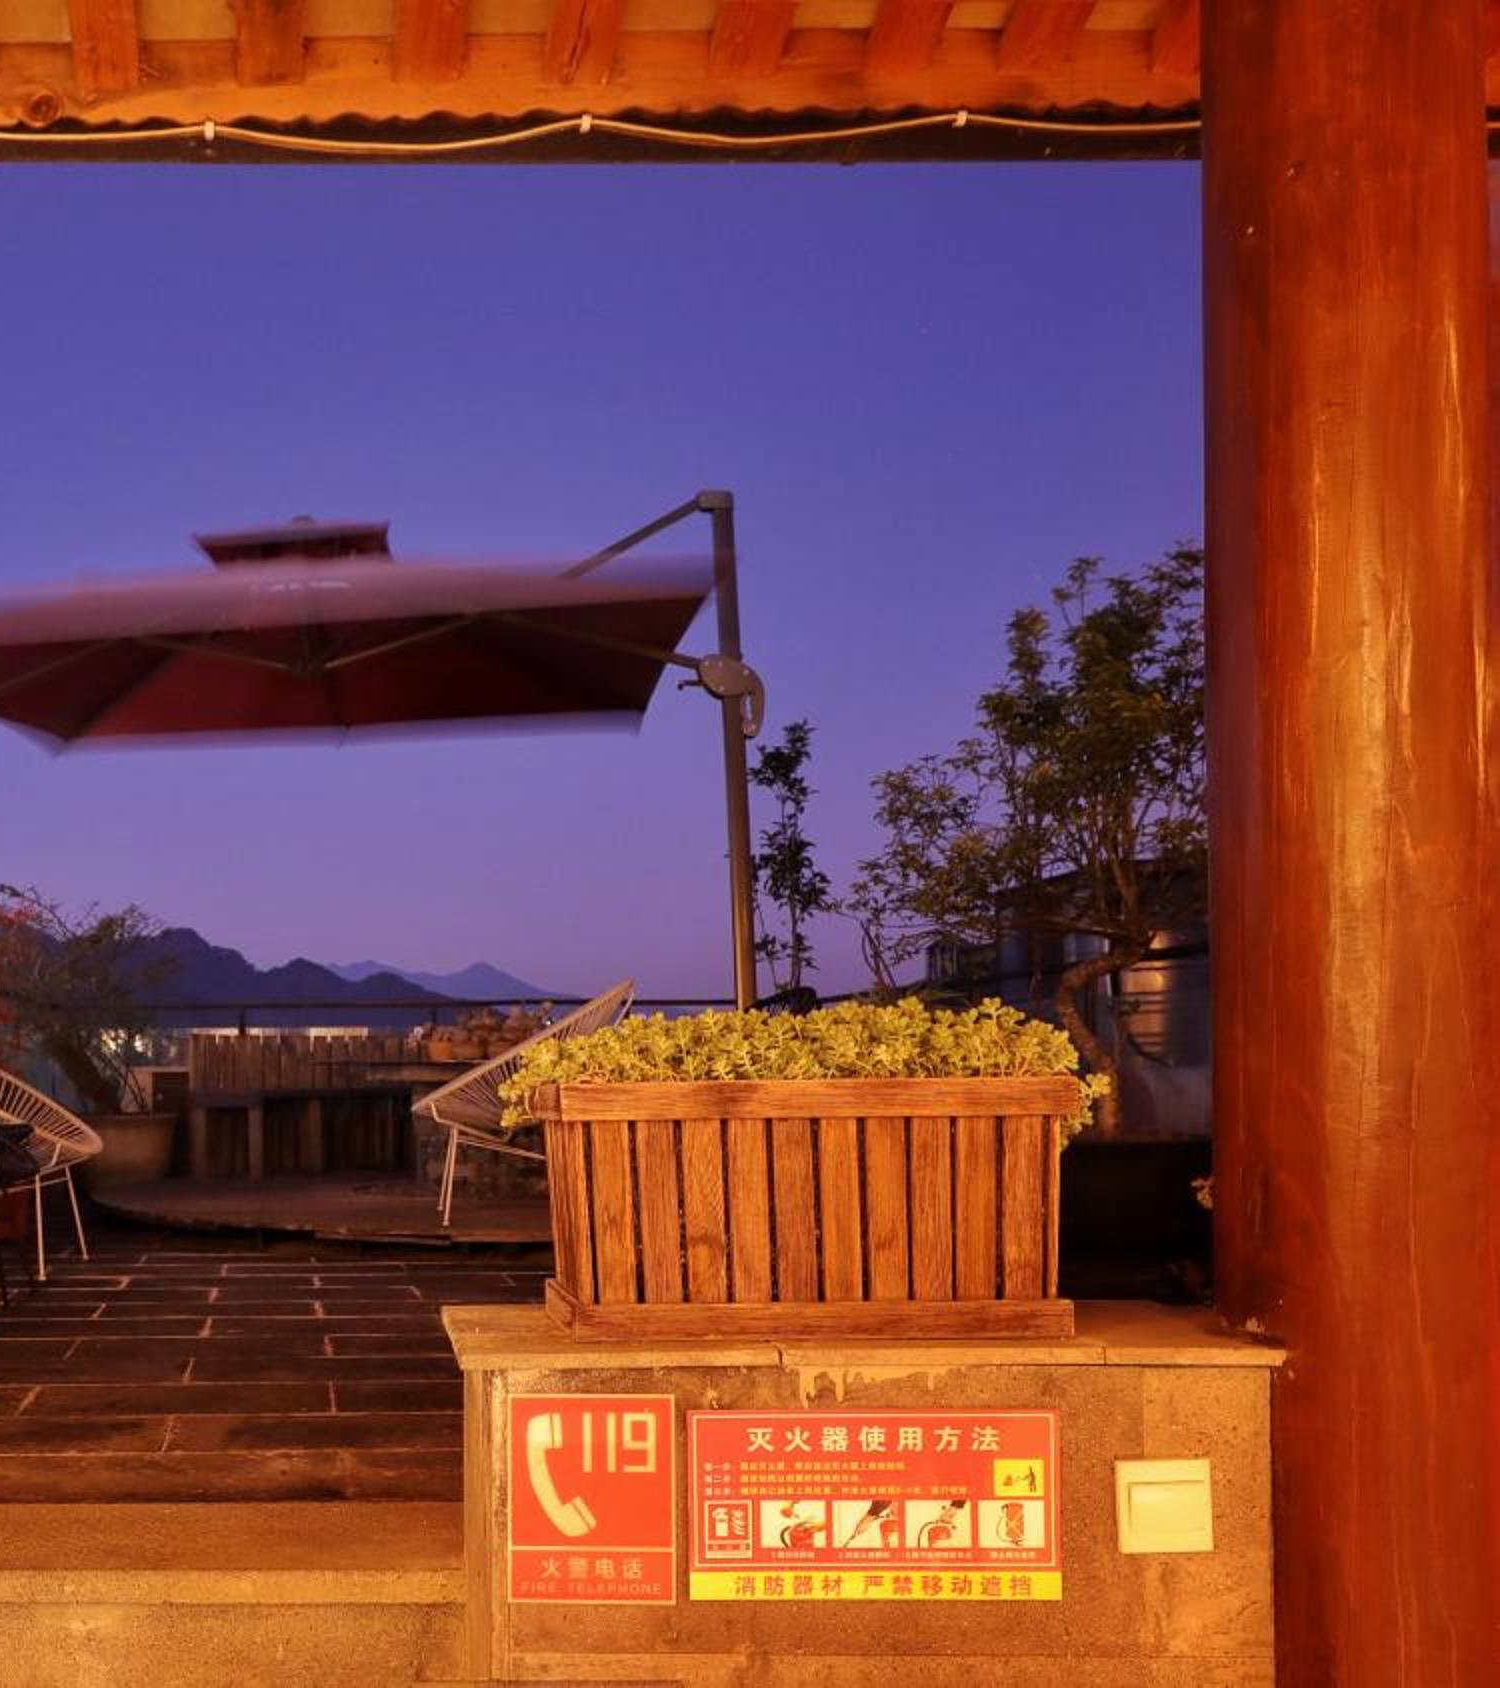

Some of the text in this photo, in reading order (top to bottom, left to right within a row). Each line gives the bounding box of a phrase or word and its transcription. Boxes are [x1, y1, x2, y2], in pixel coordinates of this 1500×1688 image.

[582, 1412, 657, 1473] 119
[746, 1426, 1001, 1452] 灭火器使用方法
[541, 1556, 644, 1580] 火警电话
[520, 1582, 556, 1594] FIRE
[734, 1575, 1034, 1597] 消防器材 严禁移动遮挡
